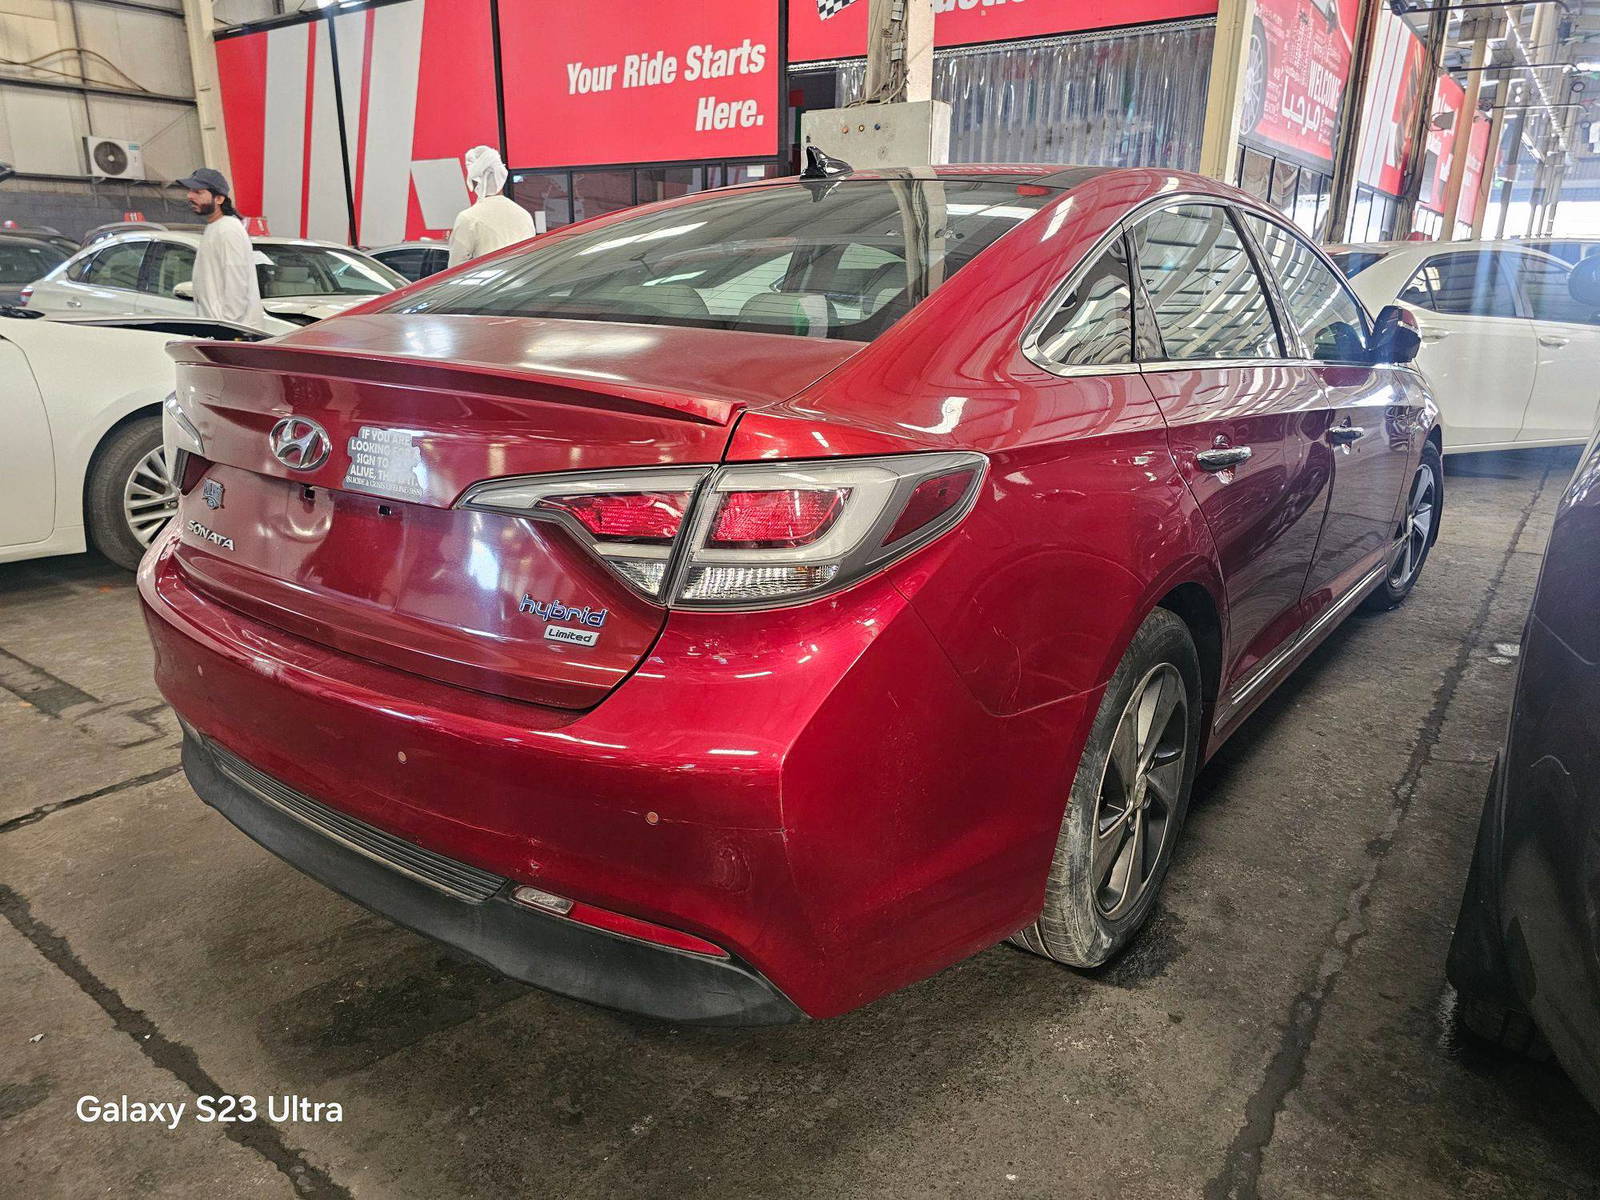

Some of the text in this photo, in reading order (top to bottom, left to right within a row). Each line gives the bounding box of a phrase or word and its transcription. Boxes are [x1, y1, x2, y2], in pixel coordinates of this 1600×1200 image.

[566, 39, 767, 95] Your Ride Starts
[1307, 61, 1341, 112] WELCOME
[695, 96, 765, 131] Here.
[1282, 75, 1321, 136] مرحبا
[351, 439, 391, 456] LOOKING
[361, 428, 411, 446] IF YOU ARE
[350, 464, 376, 480] ALIVE,
[357, 453, 376, 466] SIGN
[377, 456, 389, 468] TO
[187, 519, 234, 551] SONATA
[519, 593, 608, 627] hybrid
[548, 628, 593, 642] Limited
